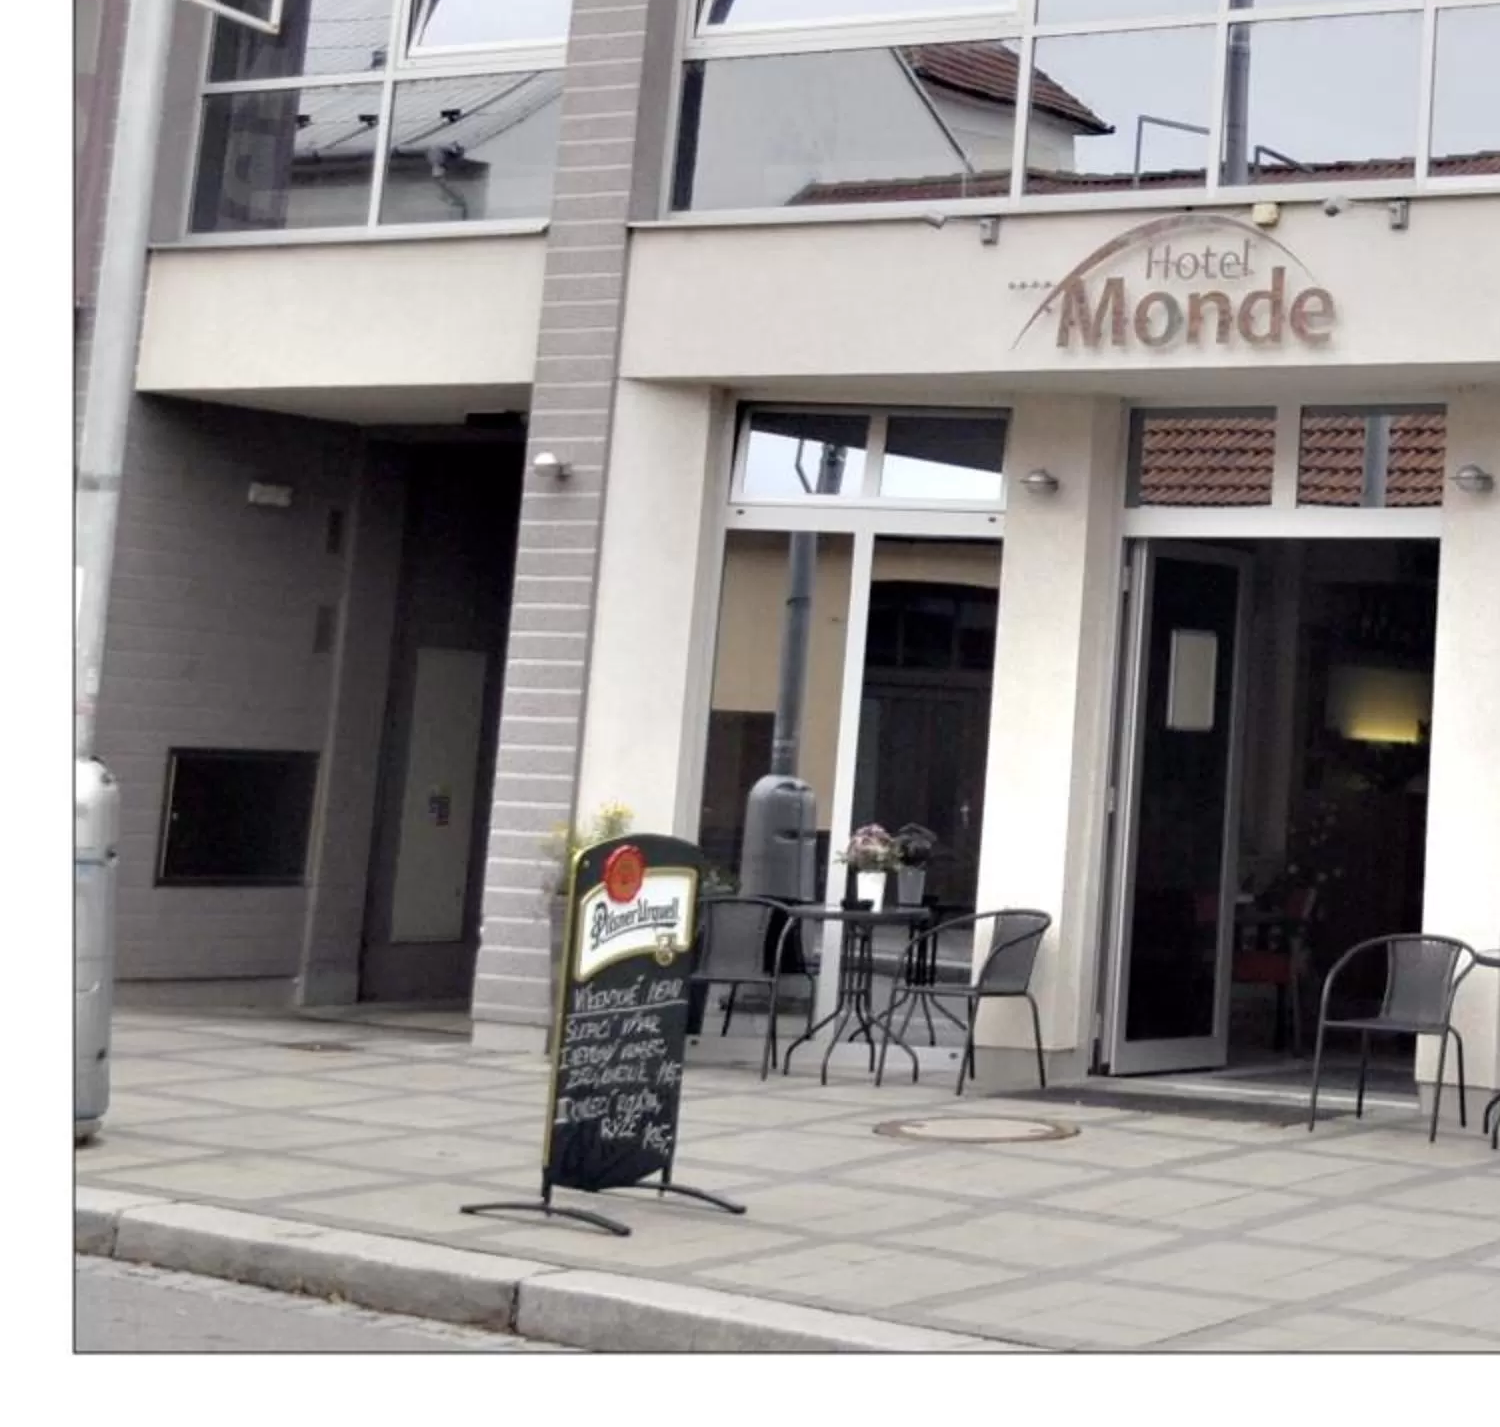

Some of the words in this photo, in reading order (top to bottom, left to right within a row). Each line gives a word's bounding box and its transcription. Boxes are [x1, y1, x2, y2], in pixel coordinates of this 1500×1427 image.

[1145, 238, 1252, 281] Hotel
[1055, 265, 1337, 349] Monde
[590, 901, 638, 950] Pilsner
